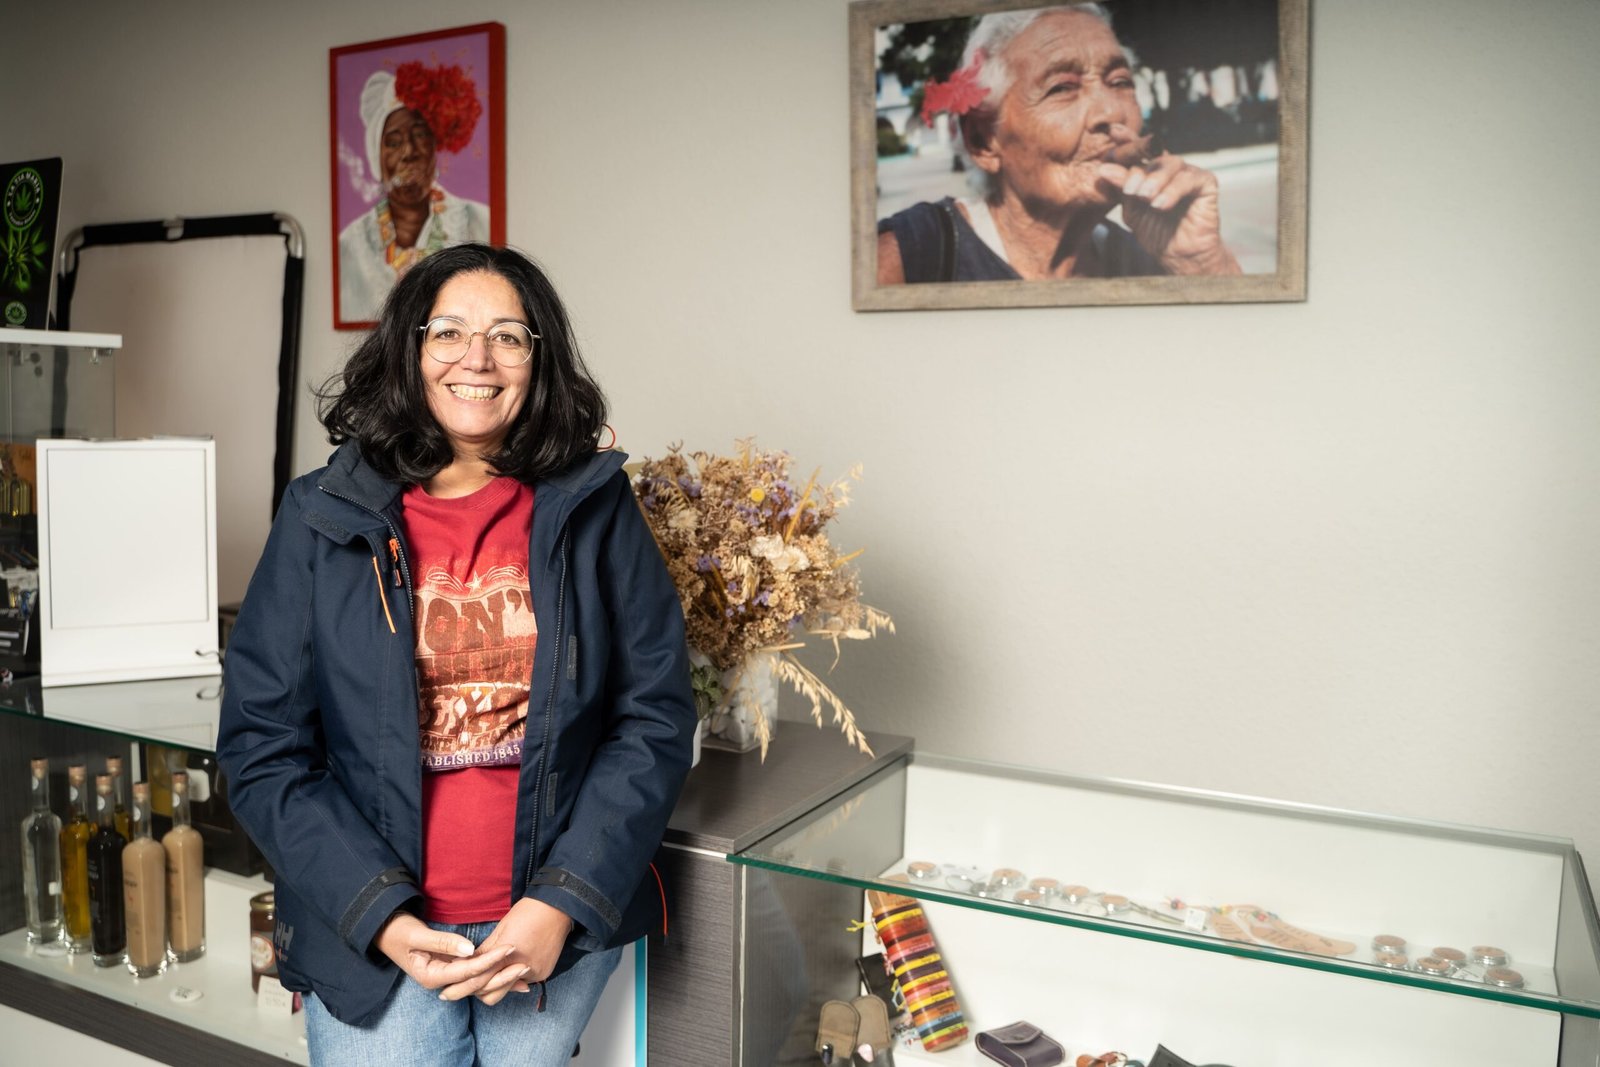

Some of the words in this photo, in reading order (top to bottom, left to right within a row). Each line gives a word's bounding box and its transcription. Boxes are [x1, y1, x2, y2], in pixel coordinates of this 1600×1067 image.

[415, 588, 534, 652] ON'
[421, 752, 490, 766] TABLISHED
[493, 744, 520, 760] 1845
